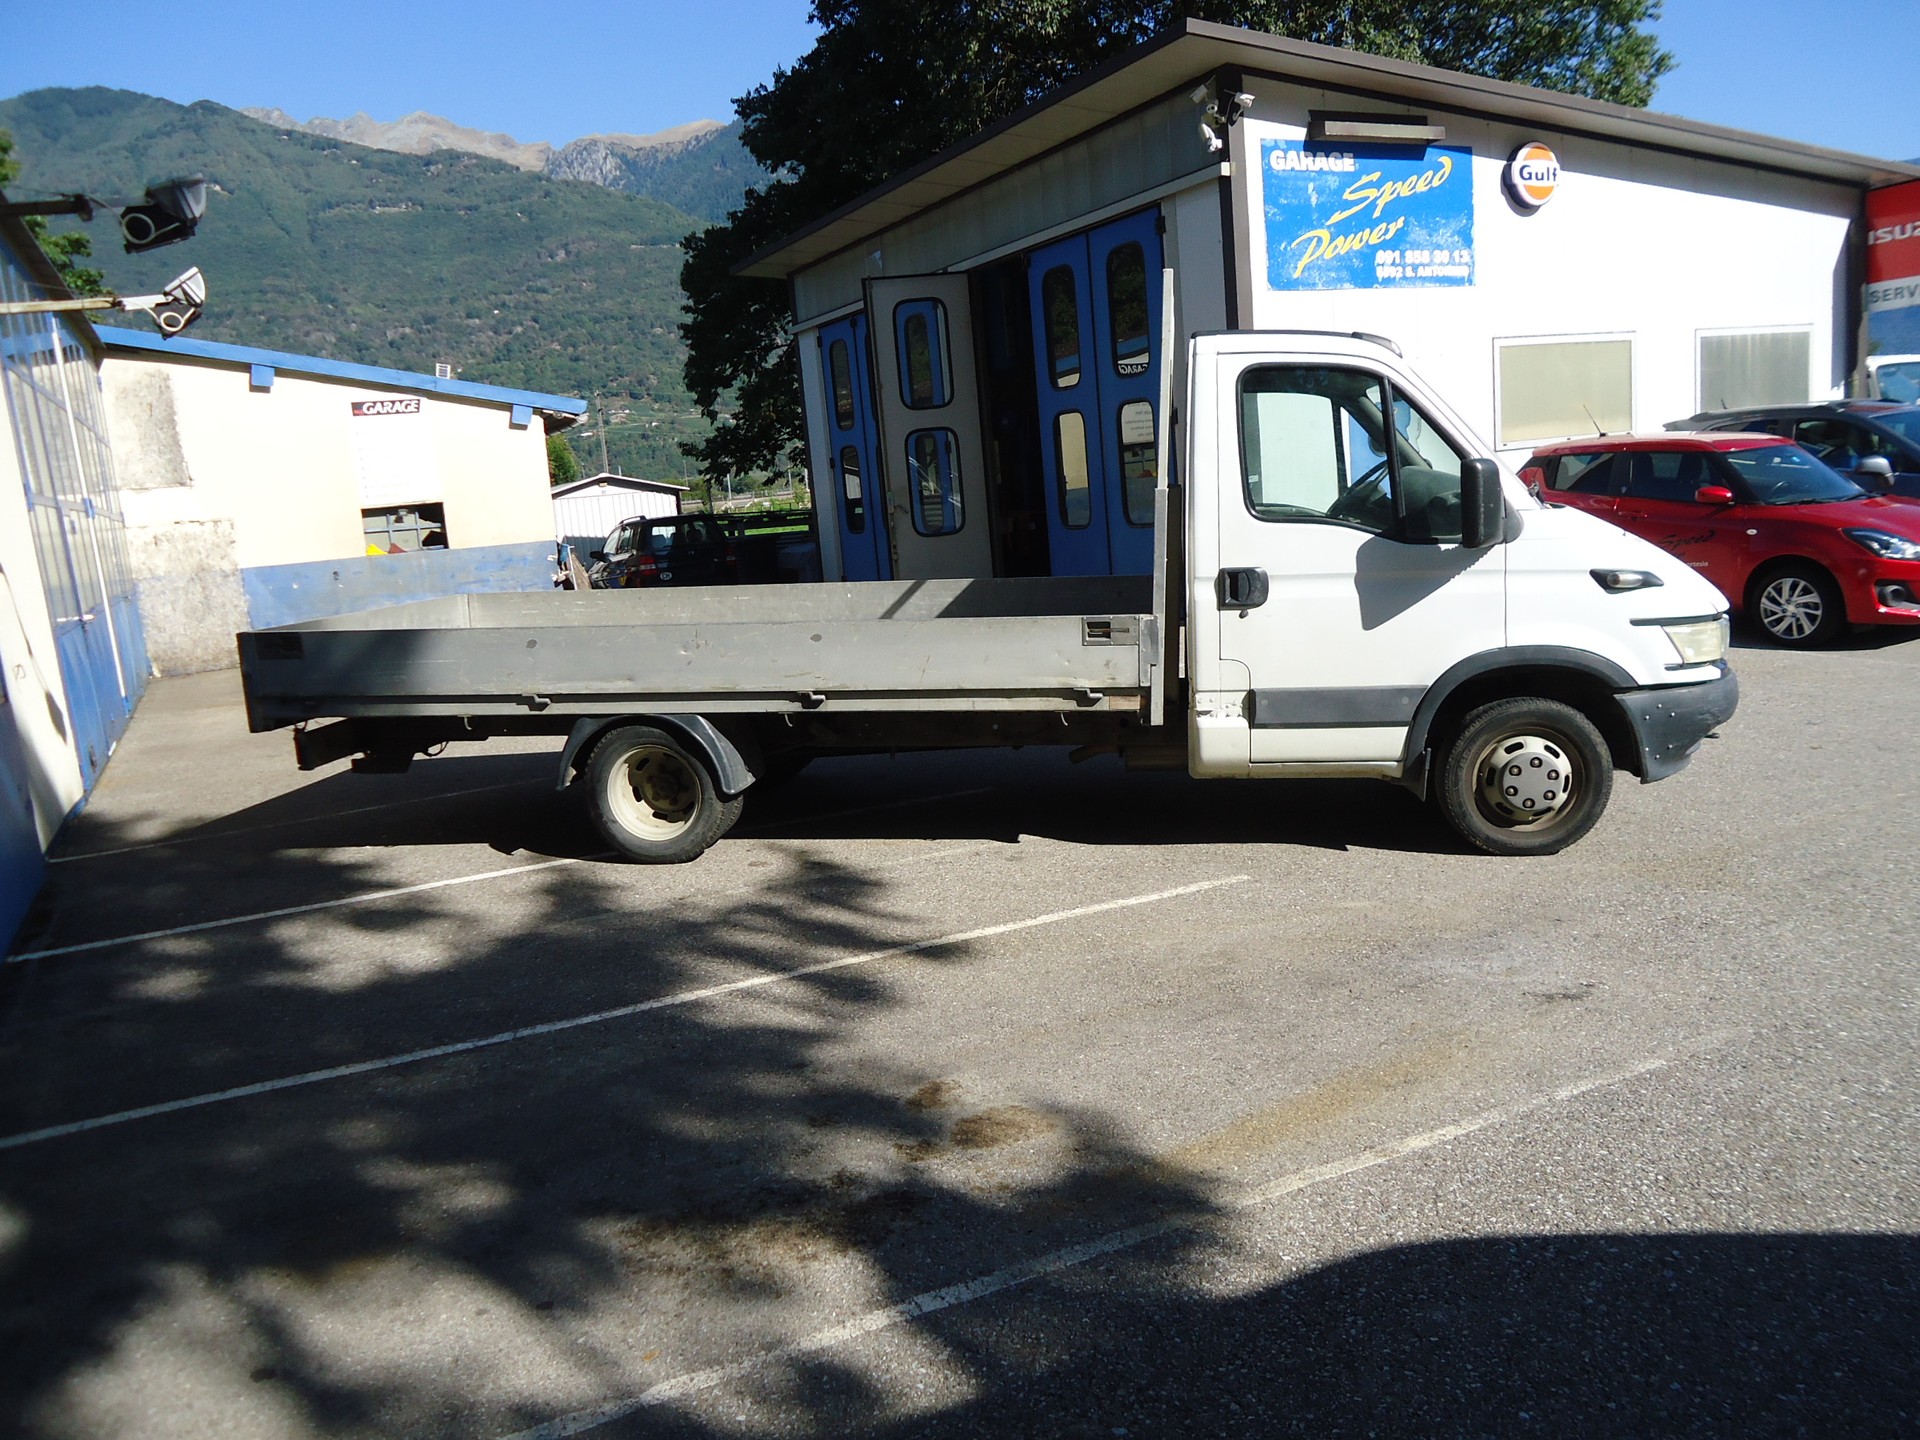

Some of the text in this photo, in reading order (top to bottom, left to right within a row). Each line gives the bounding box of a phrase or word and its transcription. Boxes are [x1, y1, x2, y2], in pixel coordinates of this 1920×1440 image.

[1269, 150, 1356, 172] GARAGE
[1519, 164, 1557, 182] Gulf
[1325, 155, 1453, 225] Speed
[1291, 215, 1405, 279] Power
[362, 400, 419, 415] GARAGE
